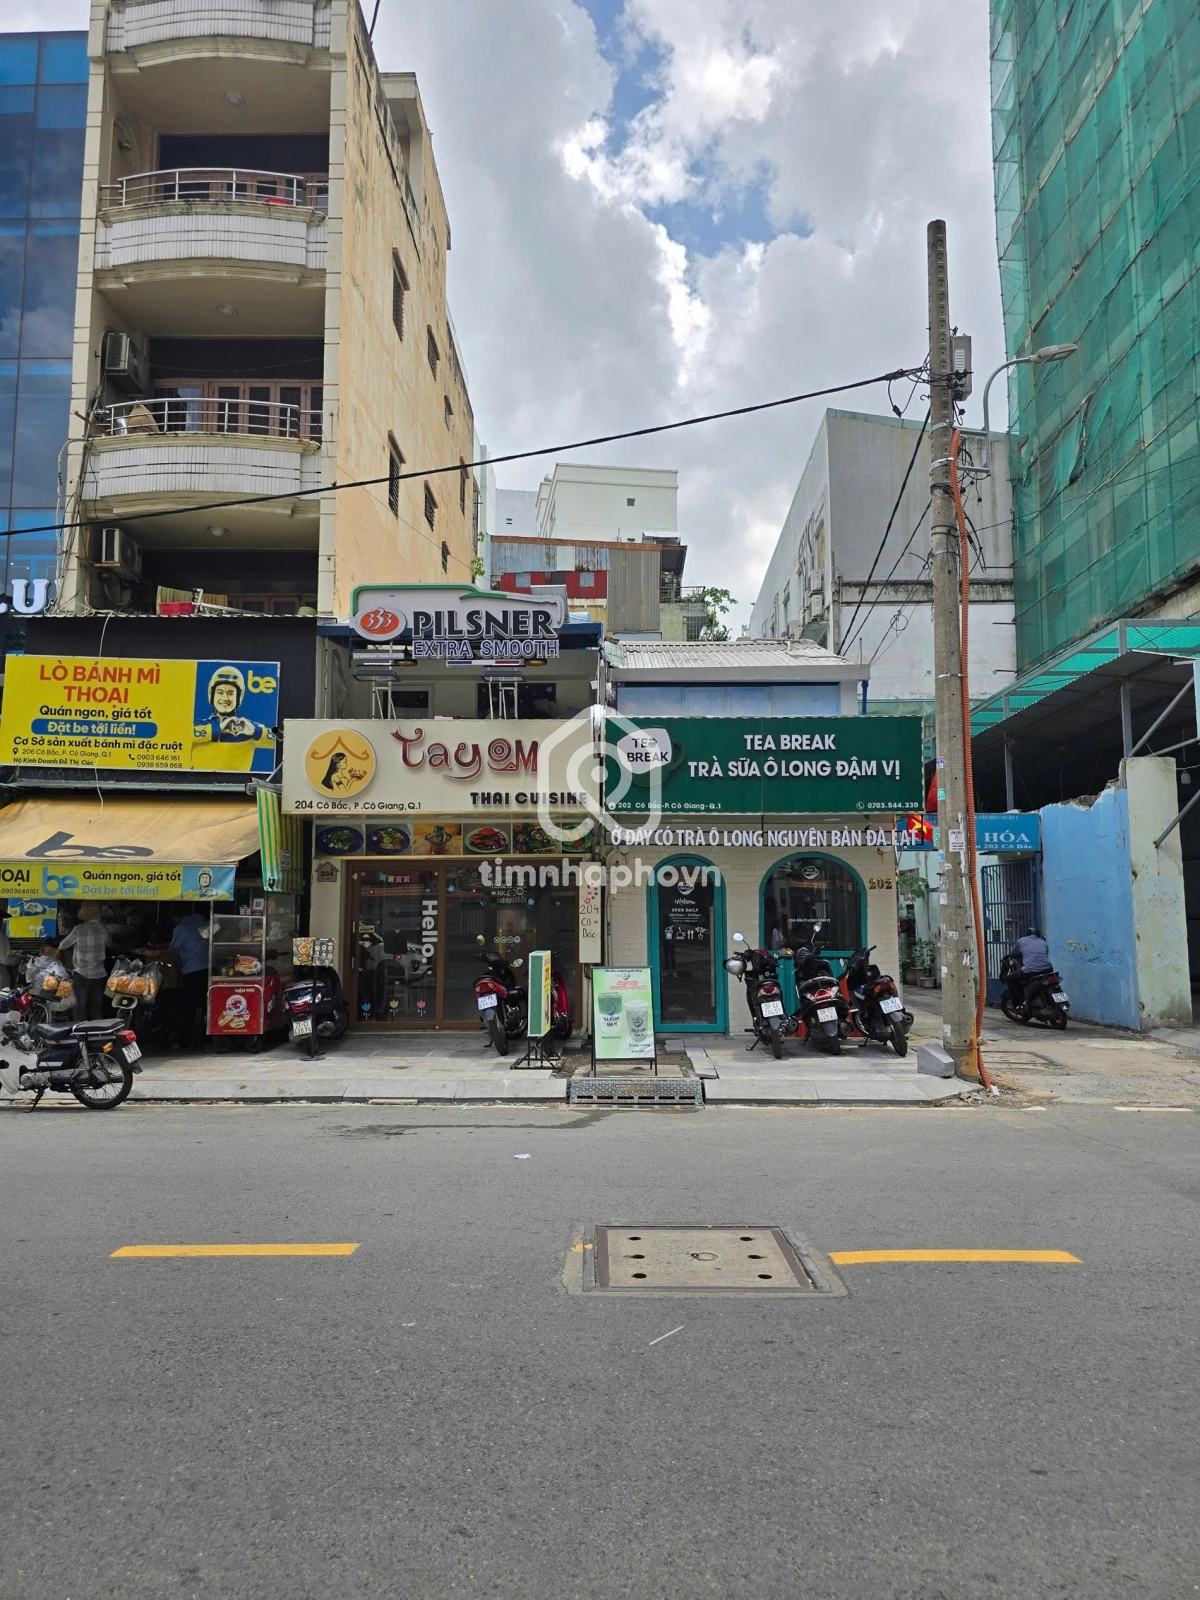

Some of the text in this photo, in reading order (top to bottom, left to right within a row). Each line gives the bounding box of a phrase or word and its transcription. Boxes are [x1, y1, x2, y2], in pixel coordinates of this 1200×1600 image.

[367, 608, 393, 631] 333
[412, 610, 559, 639] PILSNER
[413, 640, 559, 658] EXTRA SMOOTH
[40, 660, 160, 684] LÒ BÁNH MÌ
[247, 670, 277, 693] be
[64, 685, 129, 708] THOẠI
[39, 705, 152, 719] Quán ngon, giá tốt
[47, 721, 136, 735] Đặt be tới liền!
[14, 736, 183, 752] Cơ Sở sản xuất bánh mì đặc ruột
[744, 734, 836, 750] TEA BREAK
[627, 752, 668, 762] BREAK
[688, 756, 900, 780] TRÀ SỮA Ô LONG ĐẬM VỊ
[295, 800, 314, 810] 204
[316, 802, 330, 810] Cô
[332, 800, 350, 810] Bắc,
[470, 792, 587, 805] THAI CUISINE
[611, 824, 622, 846] Ở
[624, 827, 652, 846] ĐÂY
[655, 826, 673, 846] CÓ
[676, 826, 706, 846] TRÀ
[709, 827, 720, 846] Ô
[724, 830, 763, 846] LONG
[768, 828, 827, 847] NGUYÊN
[832, 826, 862, 846] BẢN
[866, 826, 887, 846] ĐÀ
[892, 830, 918, 850] LẠT
[984, 830, 1030, 843] HÓA
[0, 869, 30, 886] OẠI
[42, 866, 79, 897] be
[83, 870, 182, 882] Quán ngon, giá tốt
[869, 878, 892, 890] 202
[82, 884, 158, 897] Đặt be tới liền!
[580, 904, 599, 914] 204
[422, 900, 438, 964] Hello.
